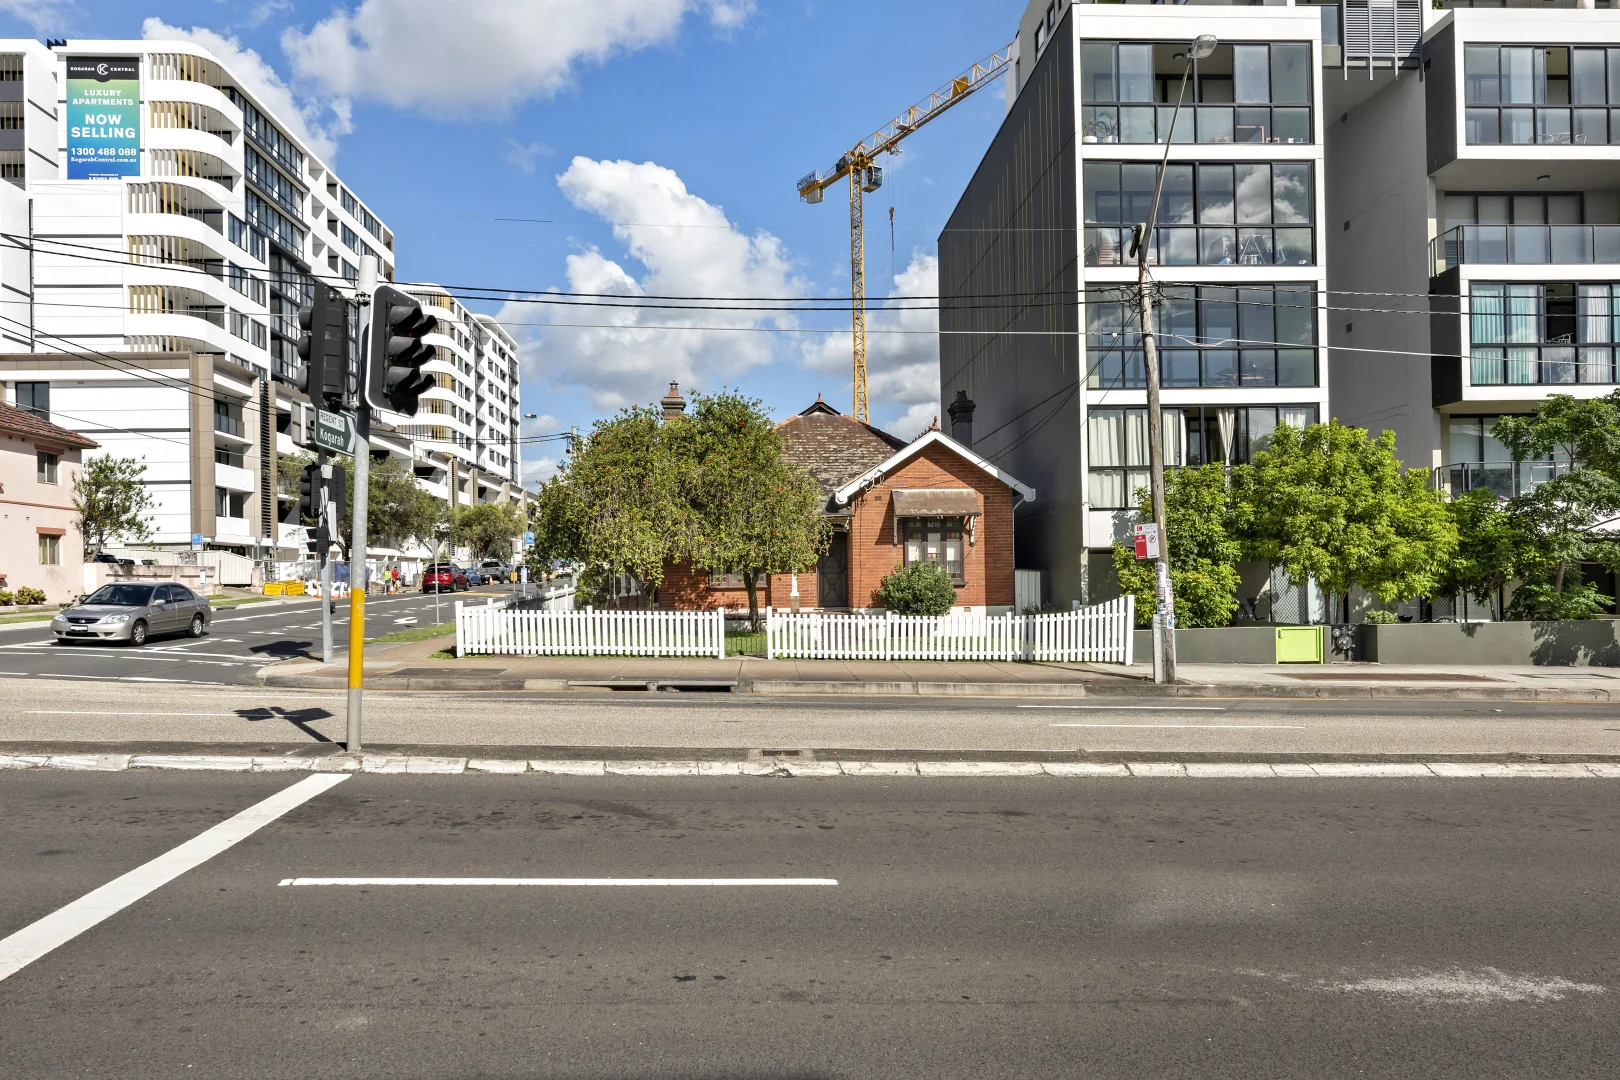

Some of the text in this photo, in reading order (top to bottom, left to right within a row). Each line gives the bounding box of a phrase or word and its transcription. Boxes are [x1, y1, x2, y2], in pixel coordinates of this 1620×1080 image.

[85, 114, 122, 125] NOW
[71, 127, 136, 139] SELLING
[71, 147, 137, 156] 1300 488 088
[320, 411, 344, 428] REGENT ST
[319, 428, 344, 446] Kogarah
